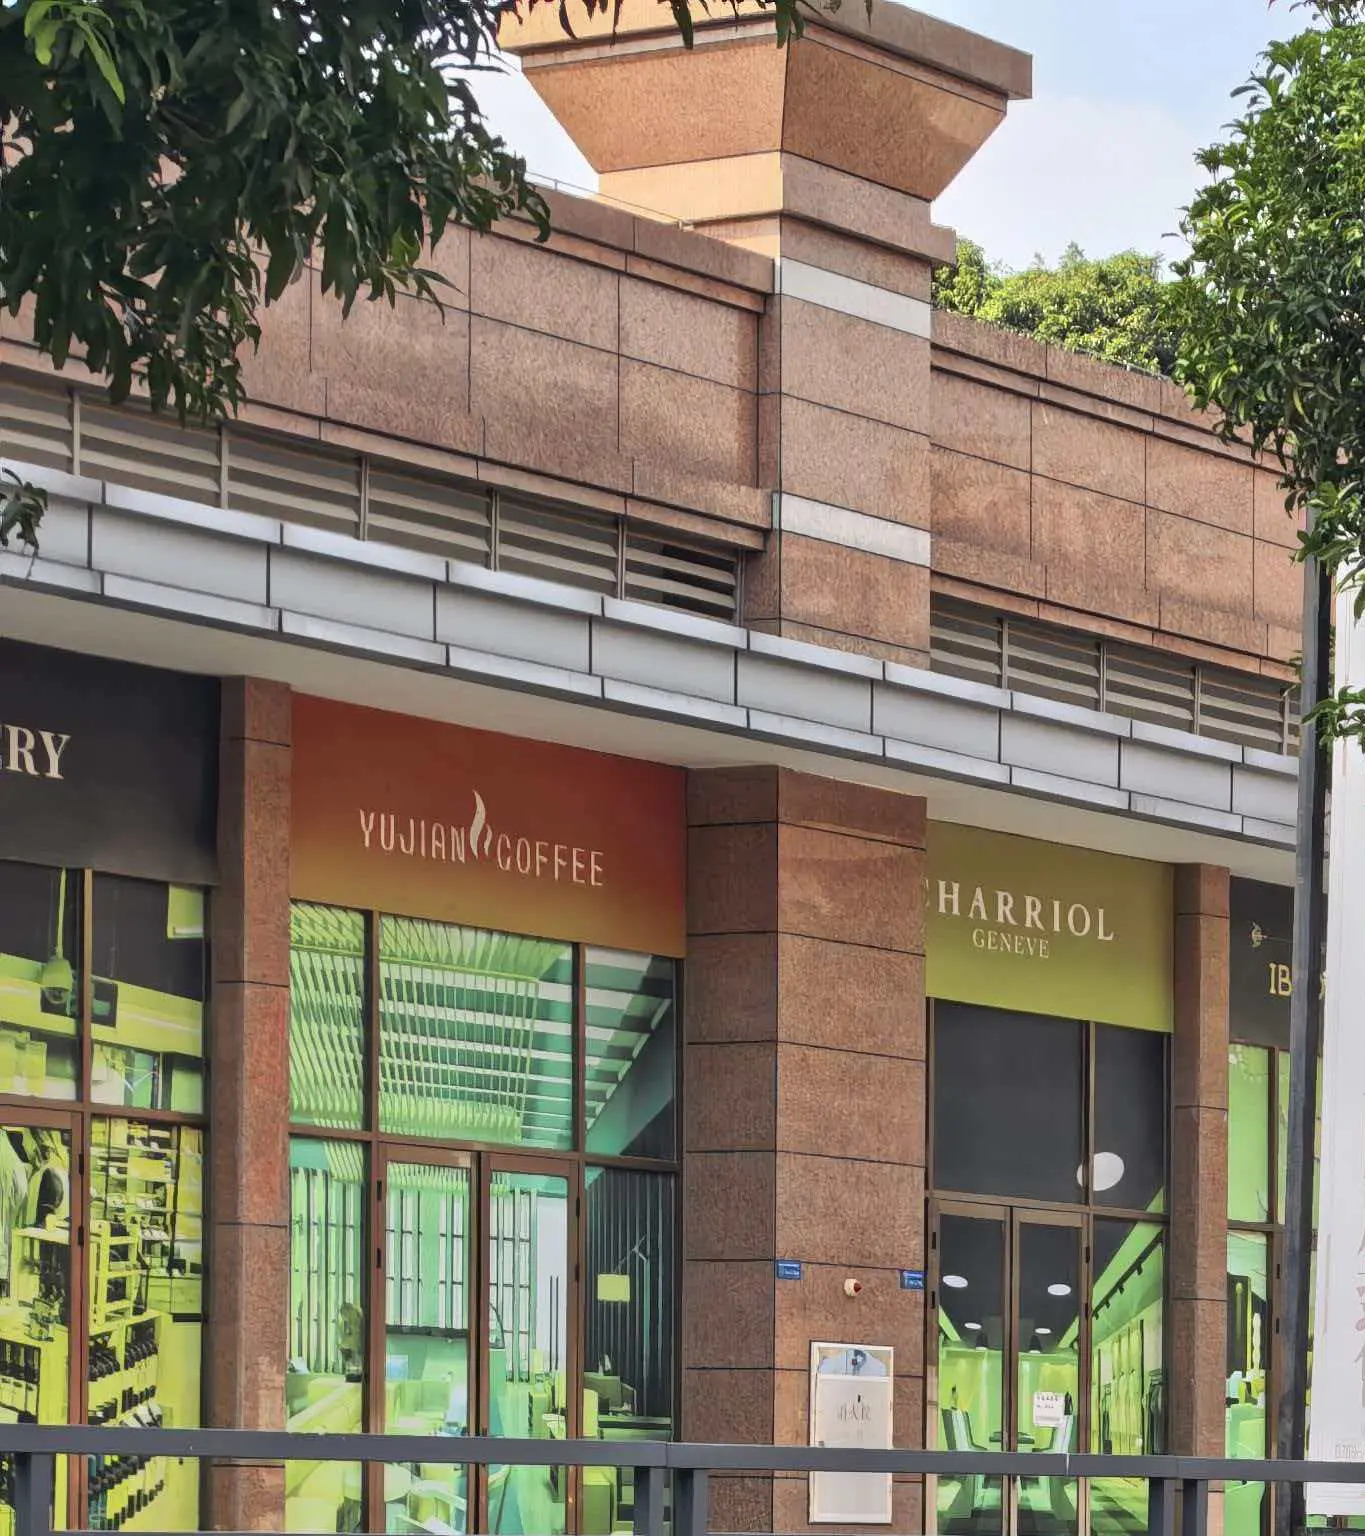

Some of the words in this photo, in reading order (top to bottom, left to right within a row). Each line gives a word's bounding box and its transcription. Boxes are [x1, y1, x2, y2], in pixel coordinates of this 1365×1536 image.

[0, 724, 71, 780] RY
[359, 809, 465, 864] YUJIAN
[497, 833, 604, 887] COFFEE
[923, 878, 1114, 941] HARRIOL
[972, 928, 1049, 958] GENEVE
